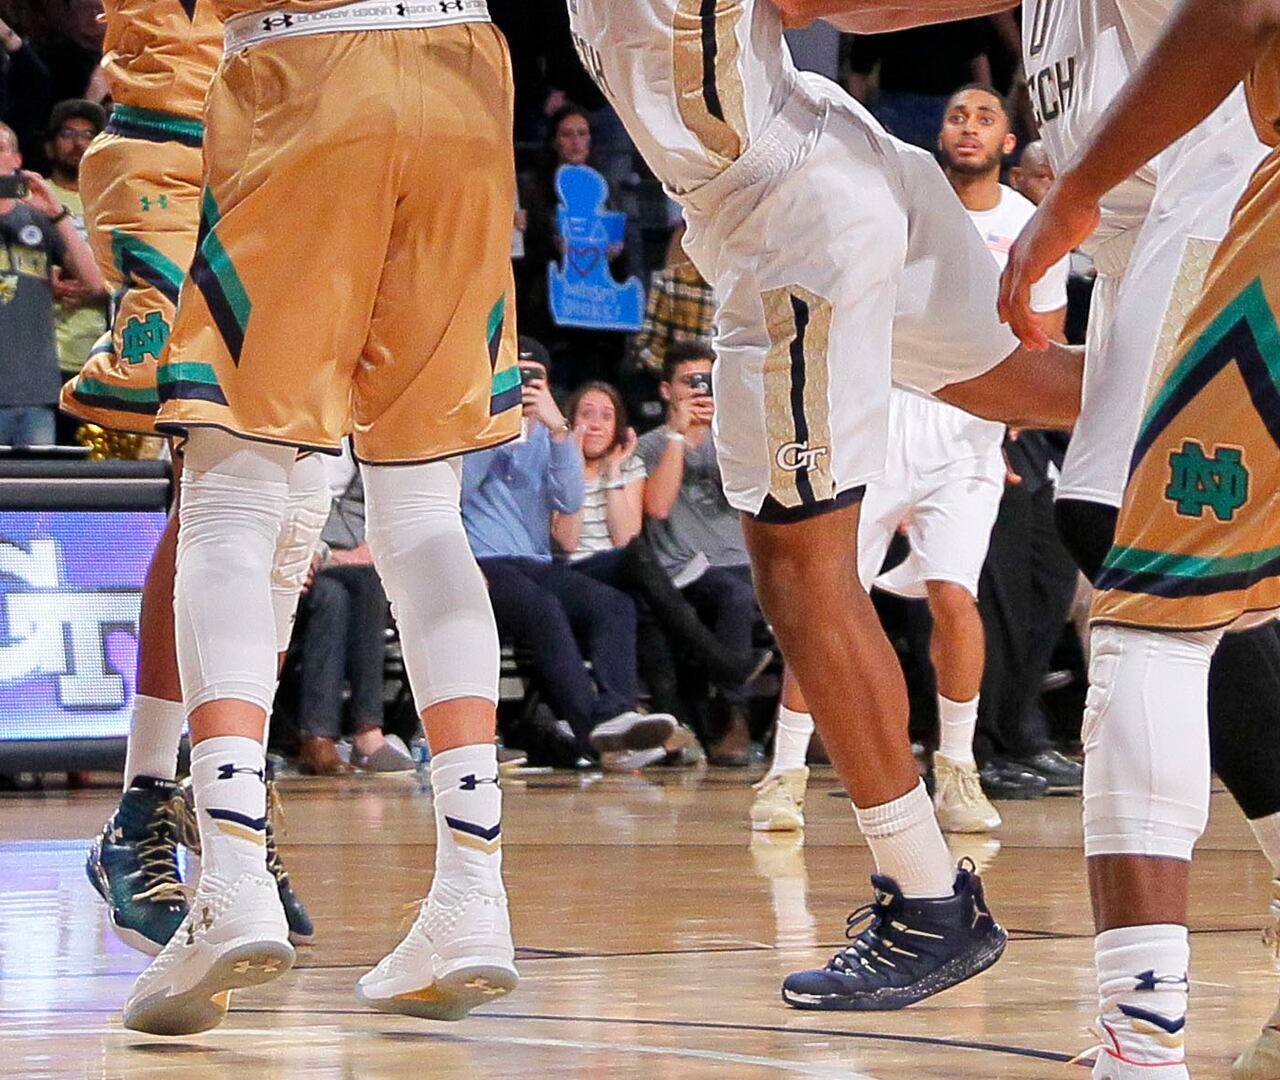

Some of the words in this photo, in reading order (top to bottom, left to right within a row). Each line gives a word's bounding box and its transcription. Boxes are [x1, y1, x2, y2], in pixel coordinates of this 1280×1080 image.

[297, 10, 349, 23] ARMOUR
[352, 7, 392, 17] UNDER
[775, 440, 828, 473] GT
